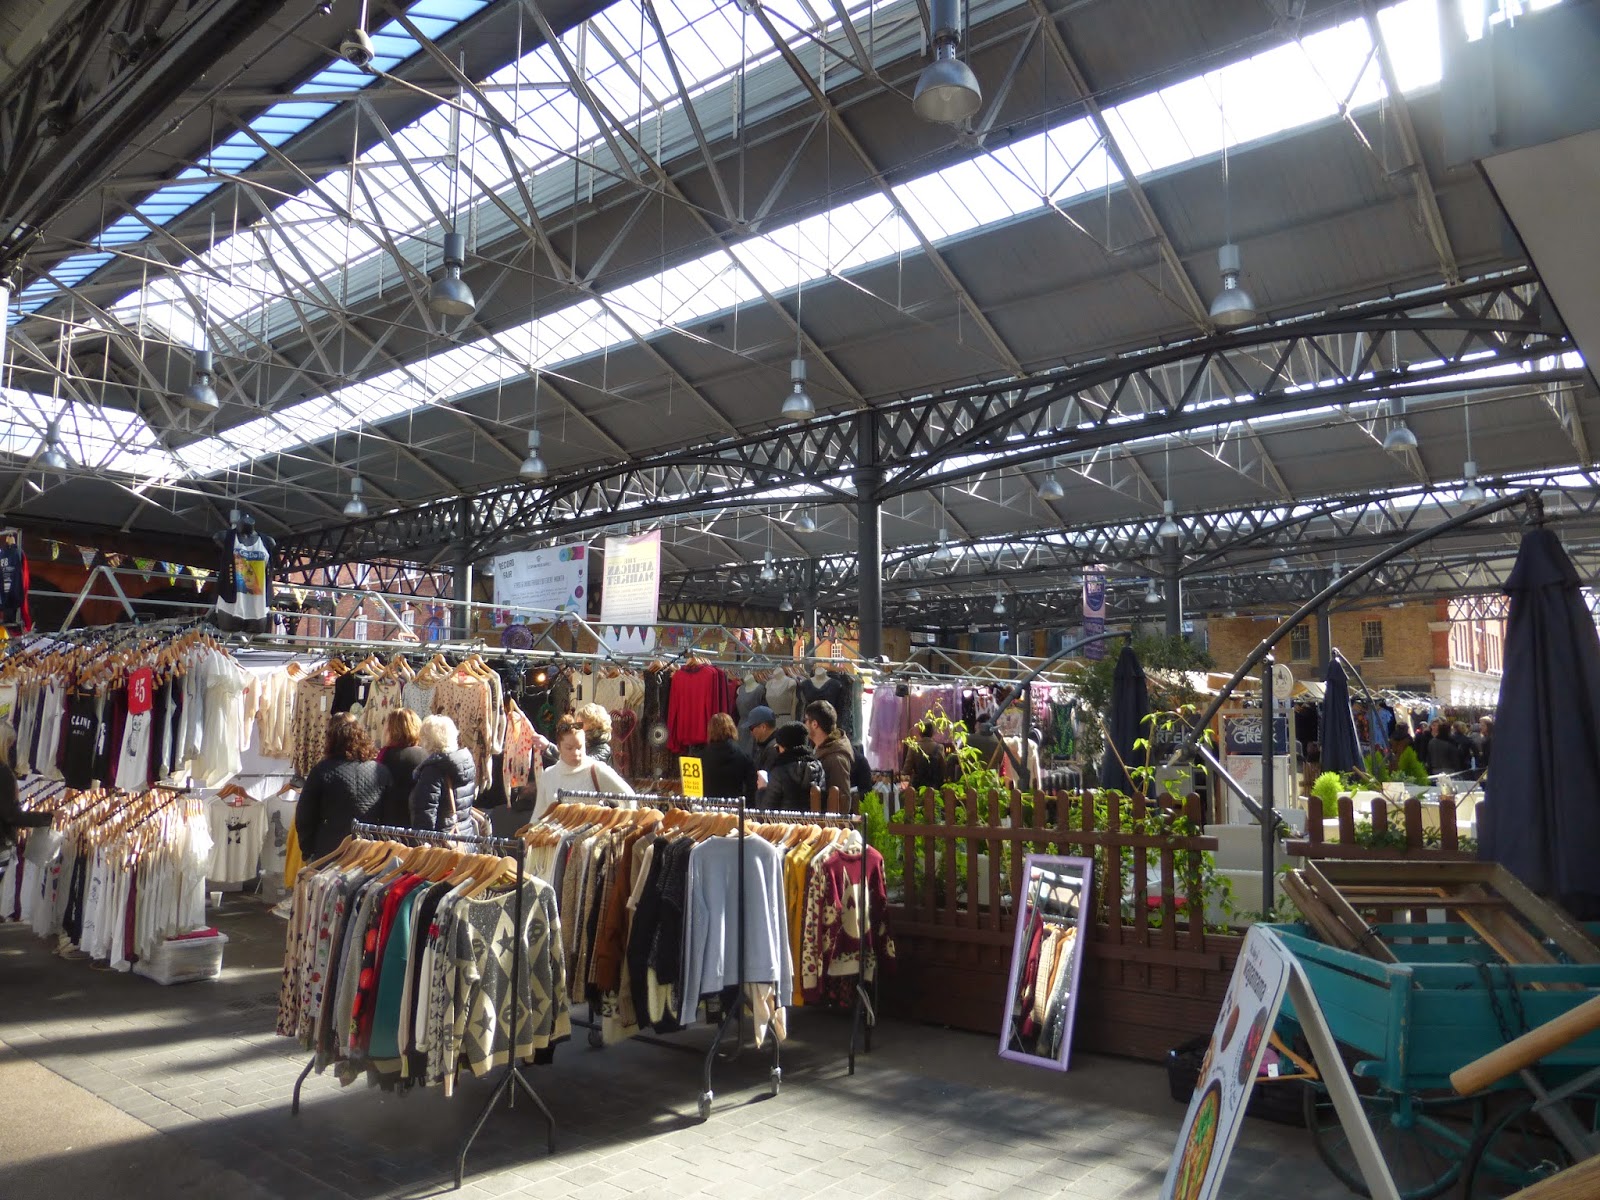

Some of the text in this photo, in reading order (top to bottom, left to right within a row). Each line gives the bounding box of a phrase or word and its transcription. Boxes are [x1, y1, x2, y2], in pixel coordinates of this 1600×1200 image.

[134, 677, 146, 703] £5
[1155, 731, 1191, 745] REEK
[1233, 731, 1278, 745] GREK
[682, 762, 701, 778] £8
